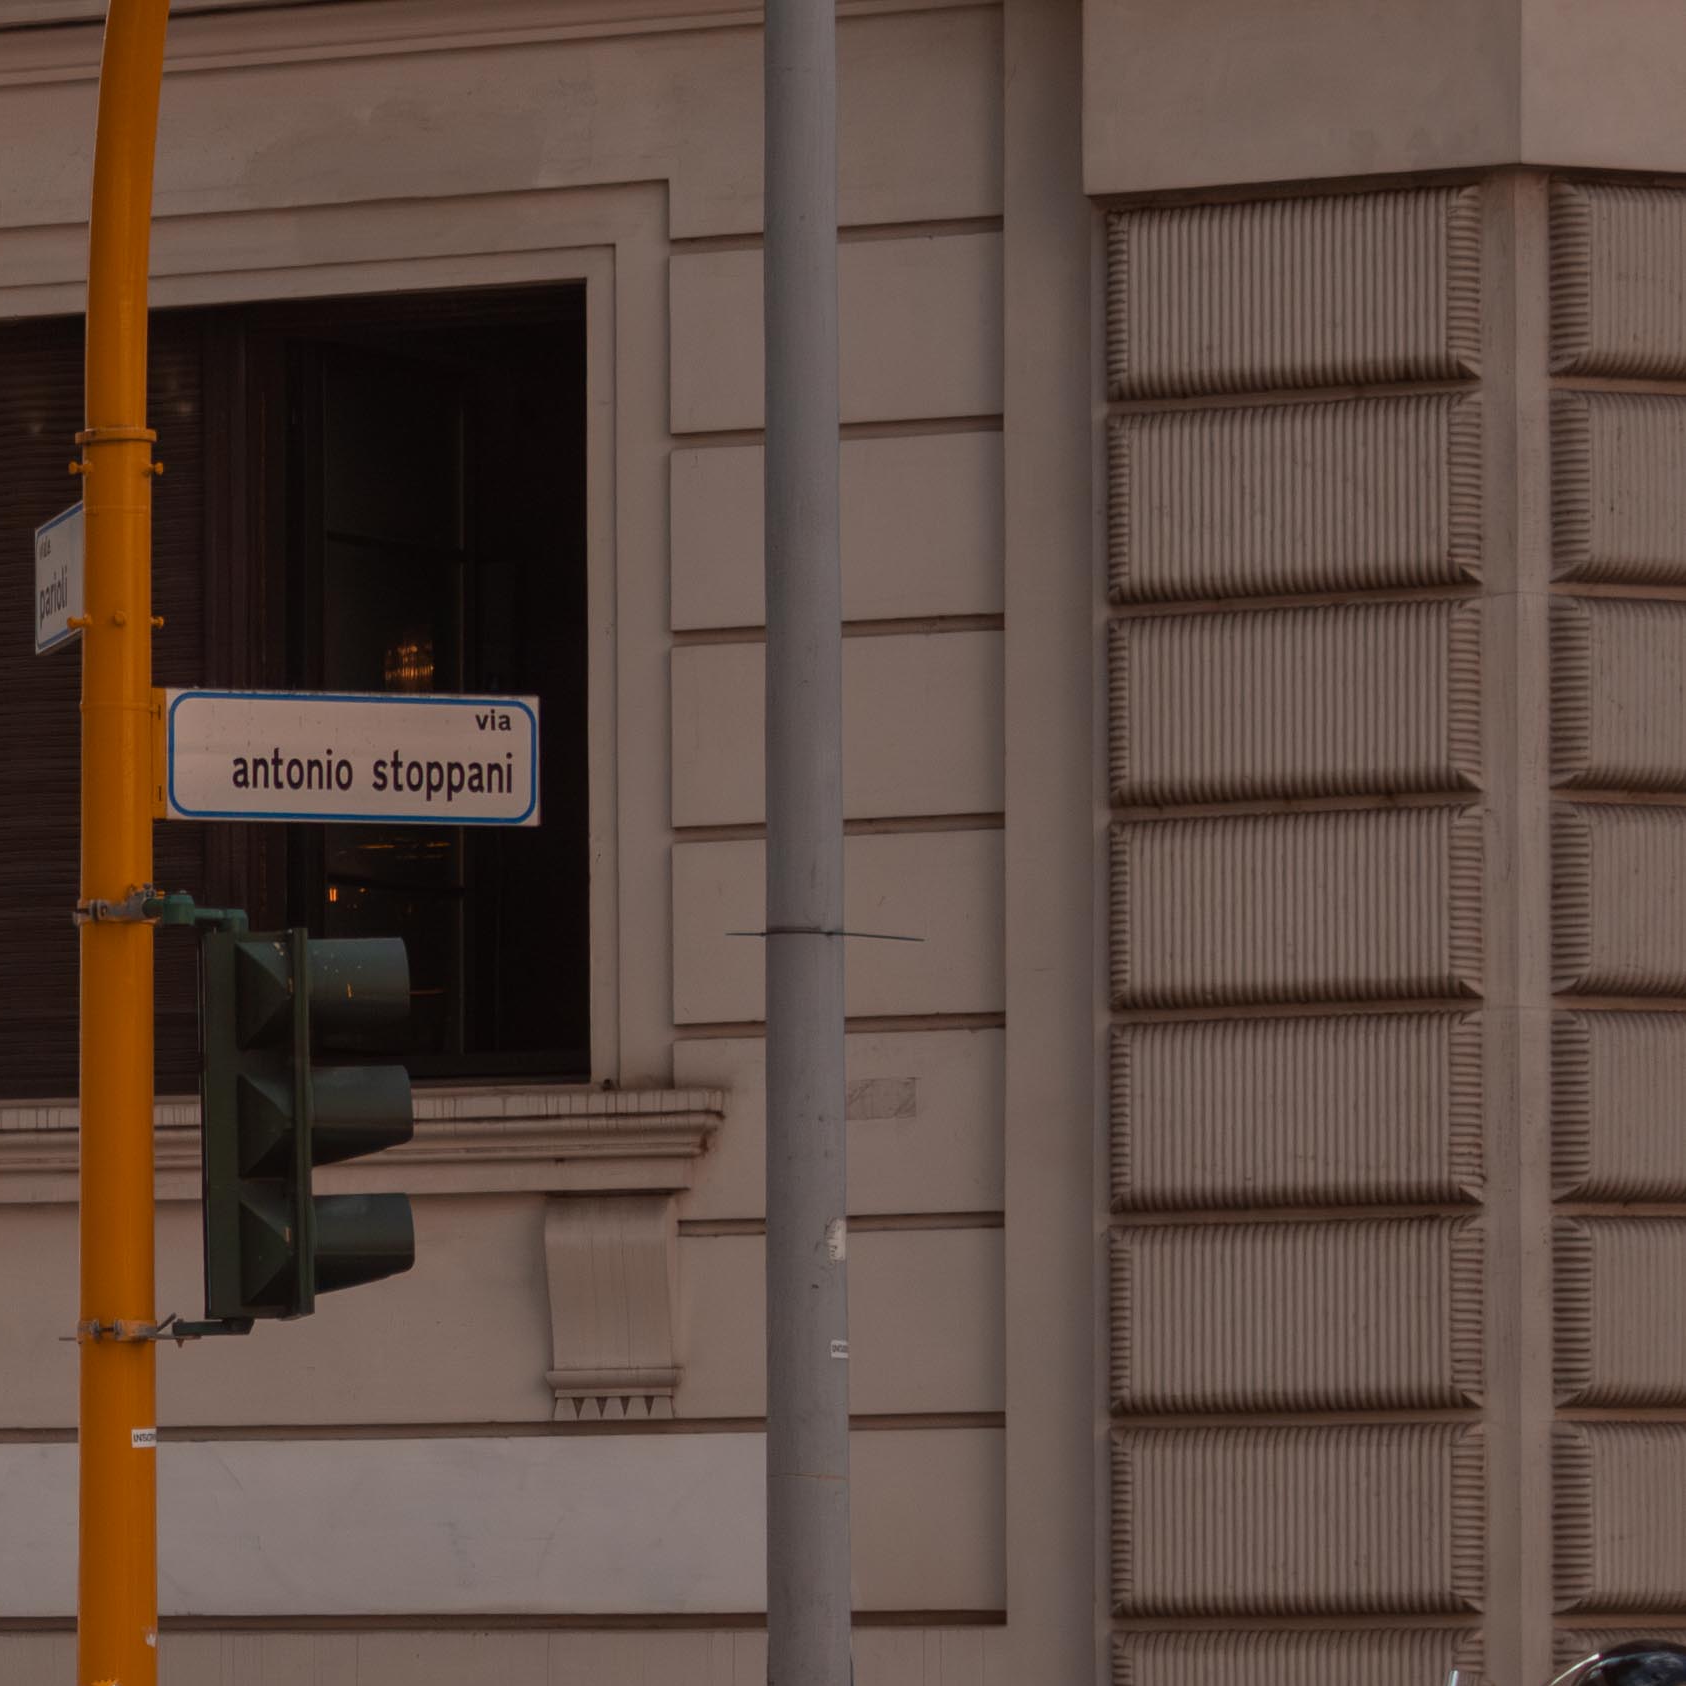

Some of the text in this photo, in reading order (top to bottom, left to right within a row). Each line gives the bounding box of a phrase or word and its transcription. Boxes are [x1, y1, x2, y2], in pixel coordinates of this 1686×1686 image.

[39, 565, 67, 629] parioli
[476, 711, 511, 731] via
[232, 749, 513, 801] antonio stoppani
